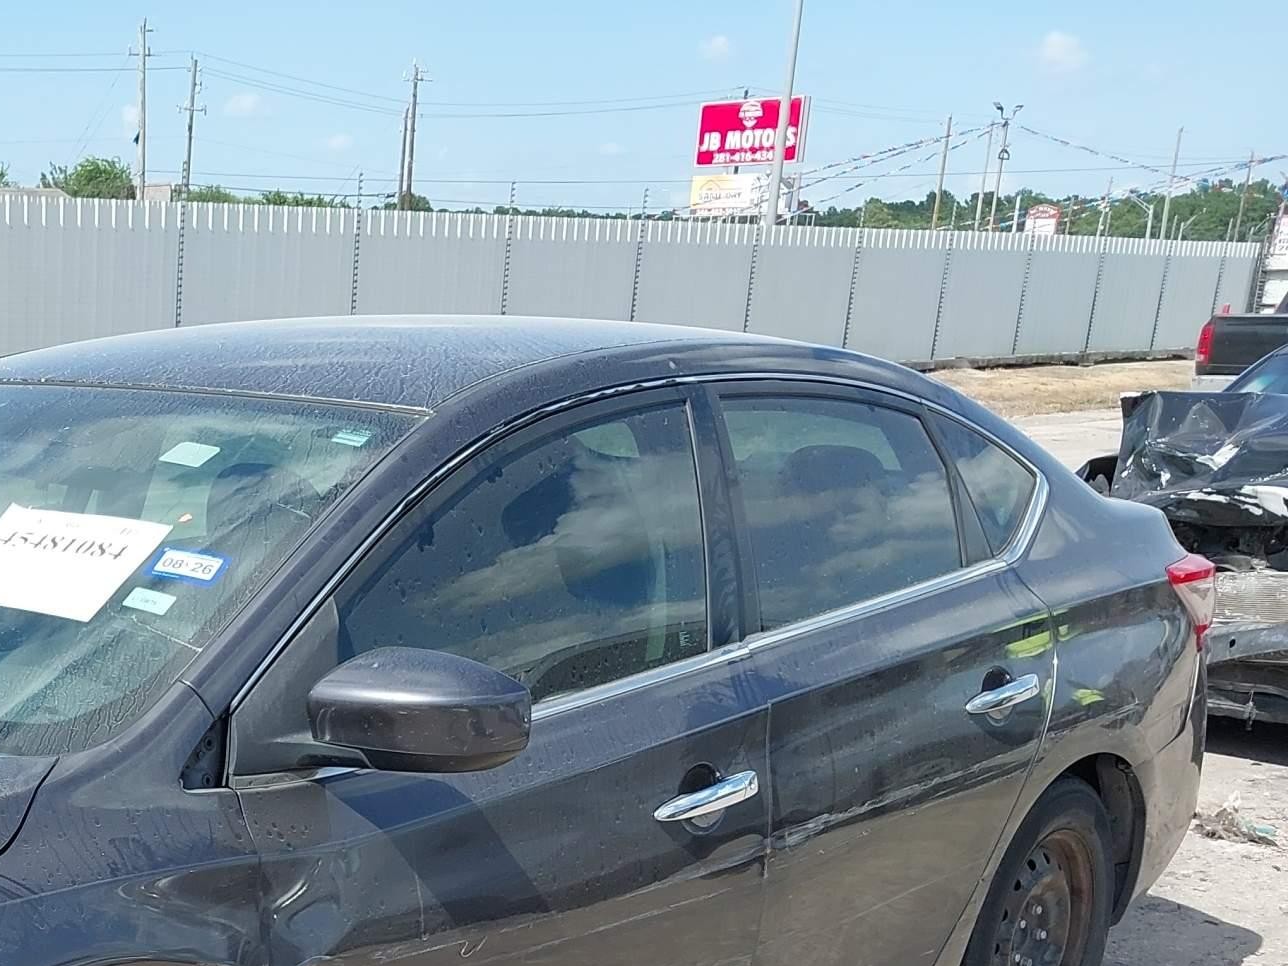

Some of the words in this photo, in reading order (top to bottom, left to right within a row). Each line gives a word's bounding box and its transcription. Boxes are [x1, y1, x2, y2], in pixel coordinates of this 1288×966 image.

[700, 132, 721, 152] JB
[725, 126, 797, 150] MOTOS
[0, 531, 128, 560] 45481084
[190, 562, 214, 575] 26
